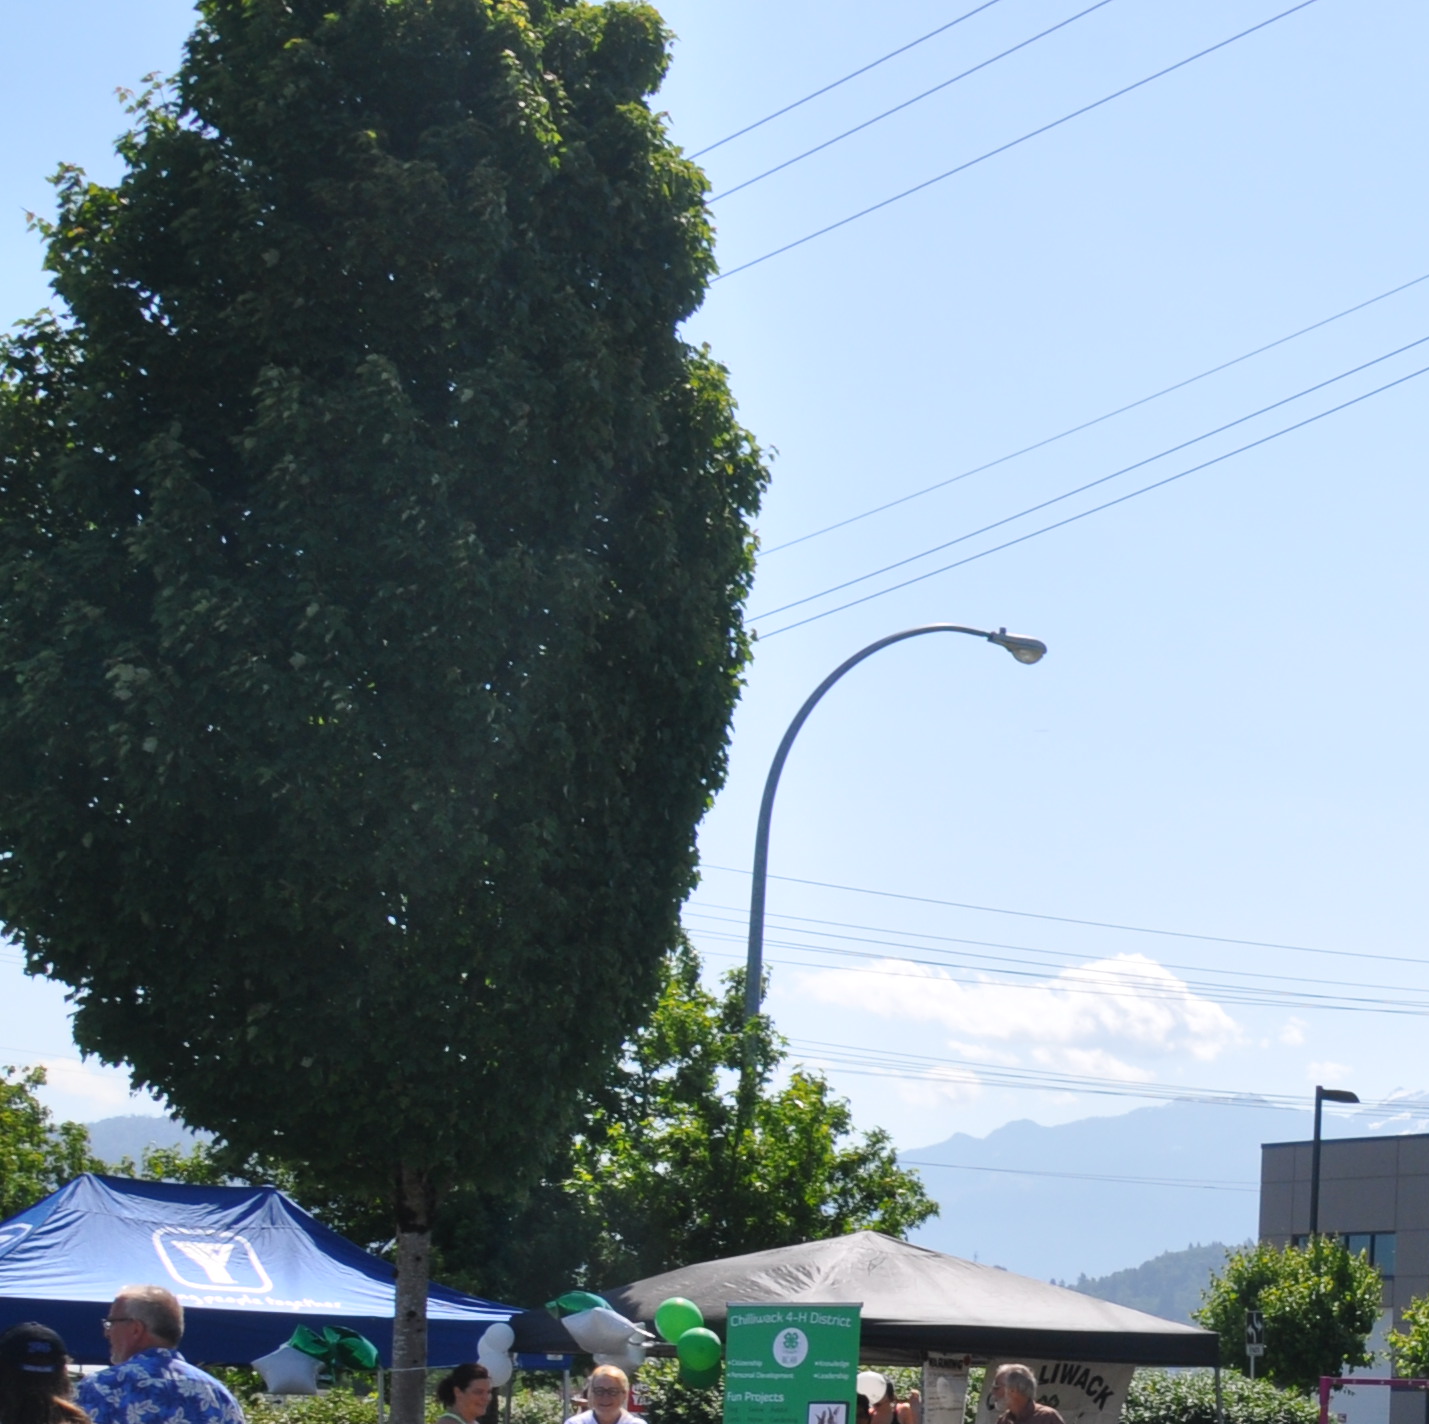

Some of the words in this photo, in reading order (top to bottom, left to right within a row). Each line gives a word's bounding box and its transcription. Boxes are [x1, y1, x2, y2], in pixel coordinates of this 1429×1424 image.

[730, 1311, 783, 1327] Chilliwack
[785, 1311, 807, 1323] 4-H
[810, 1312, 852, 1328] District
[727, 1392, 743, 1401] Fun
[745, 1391, 785, 1404] Projects
